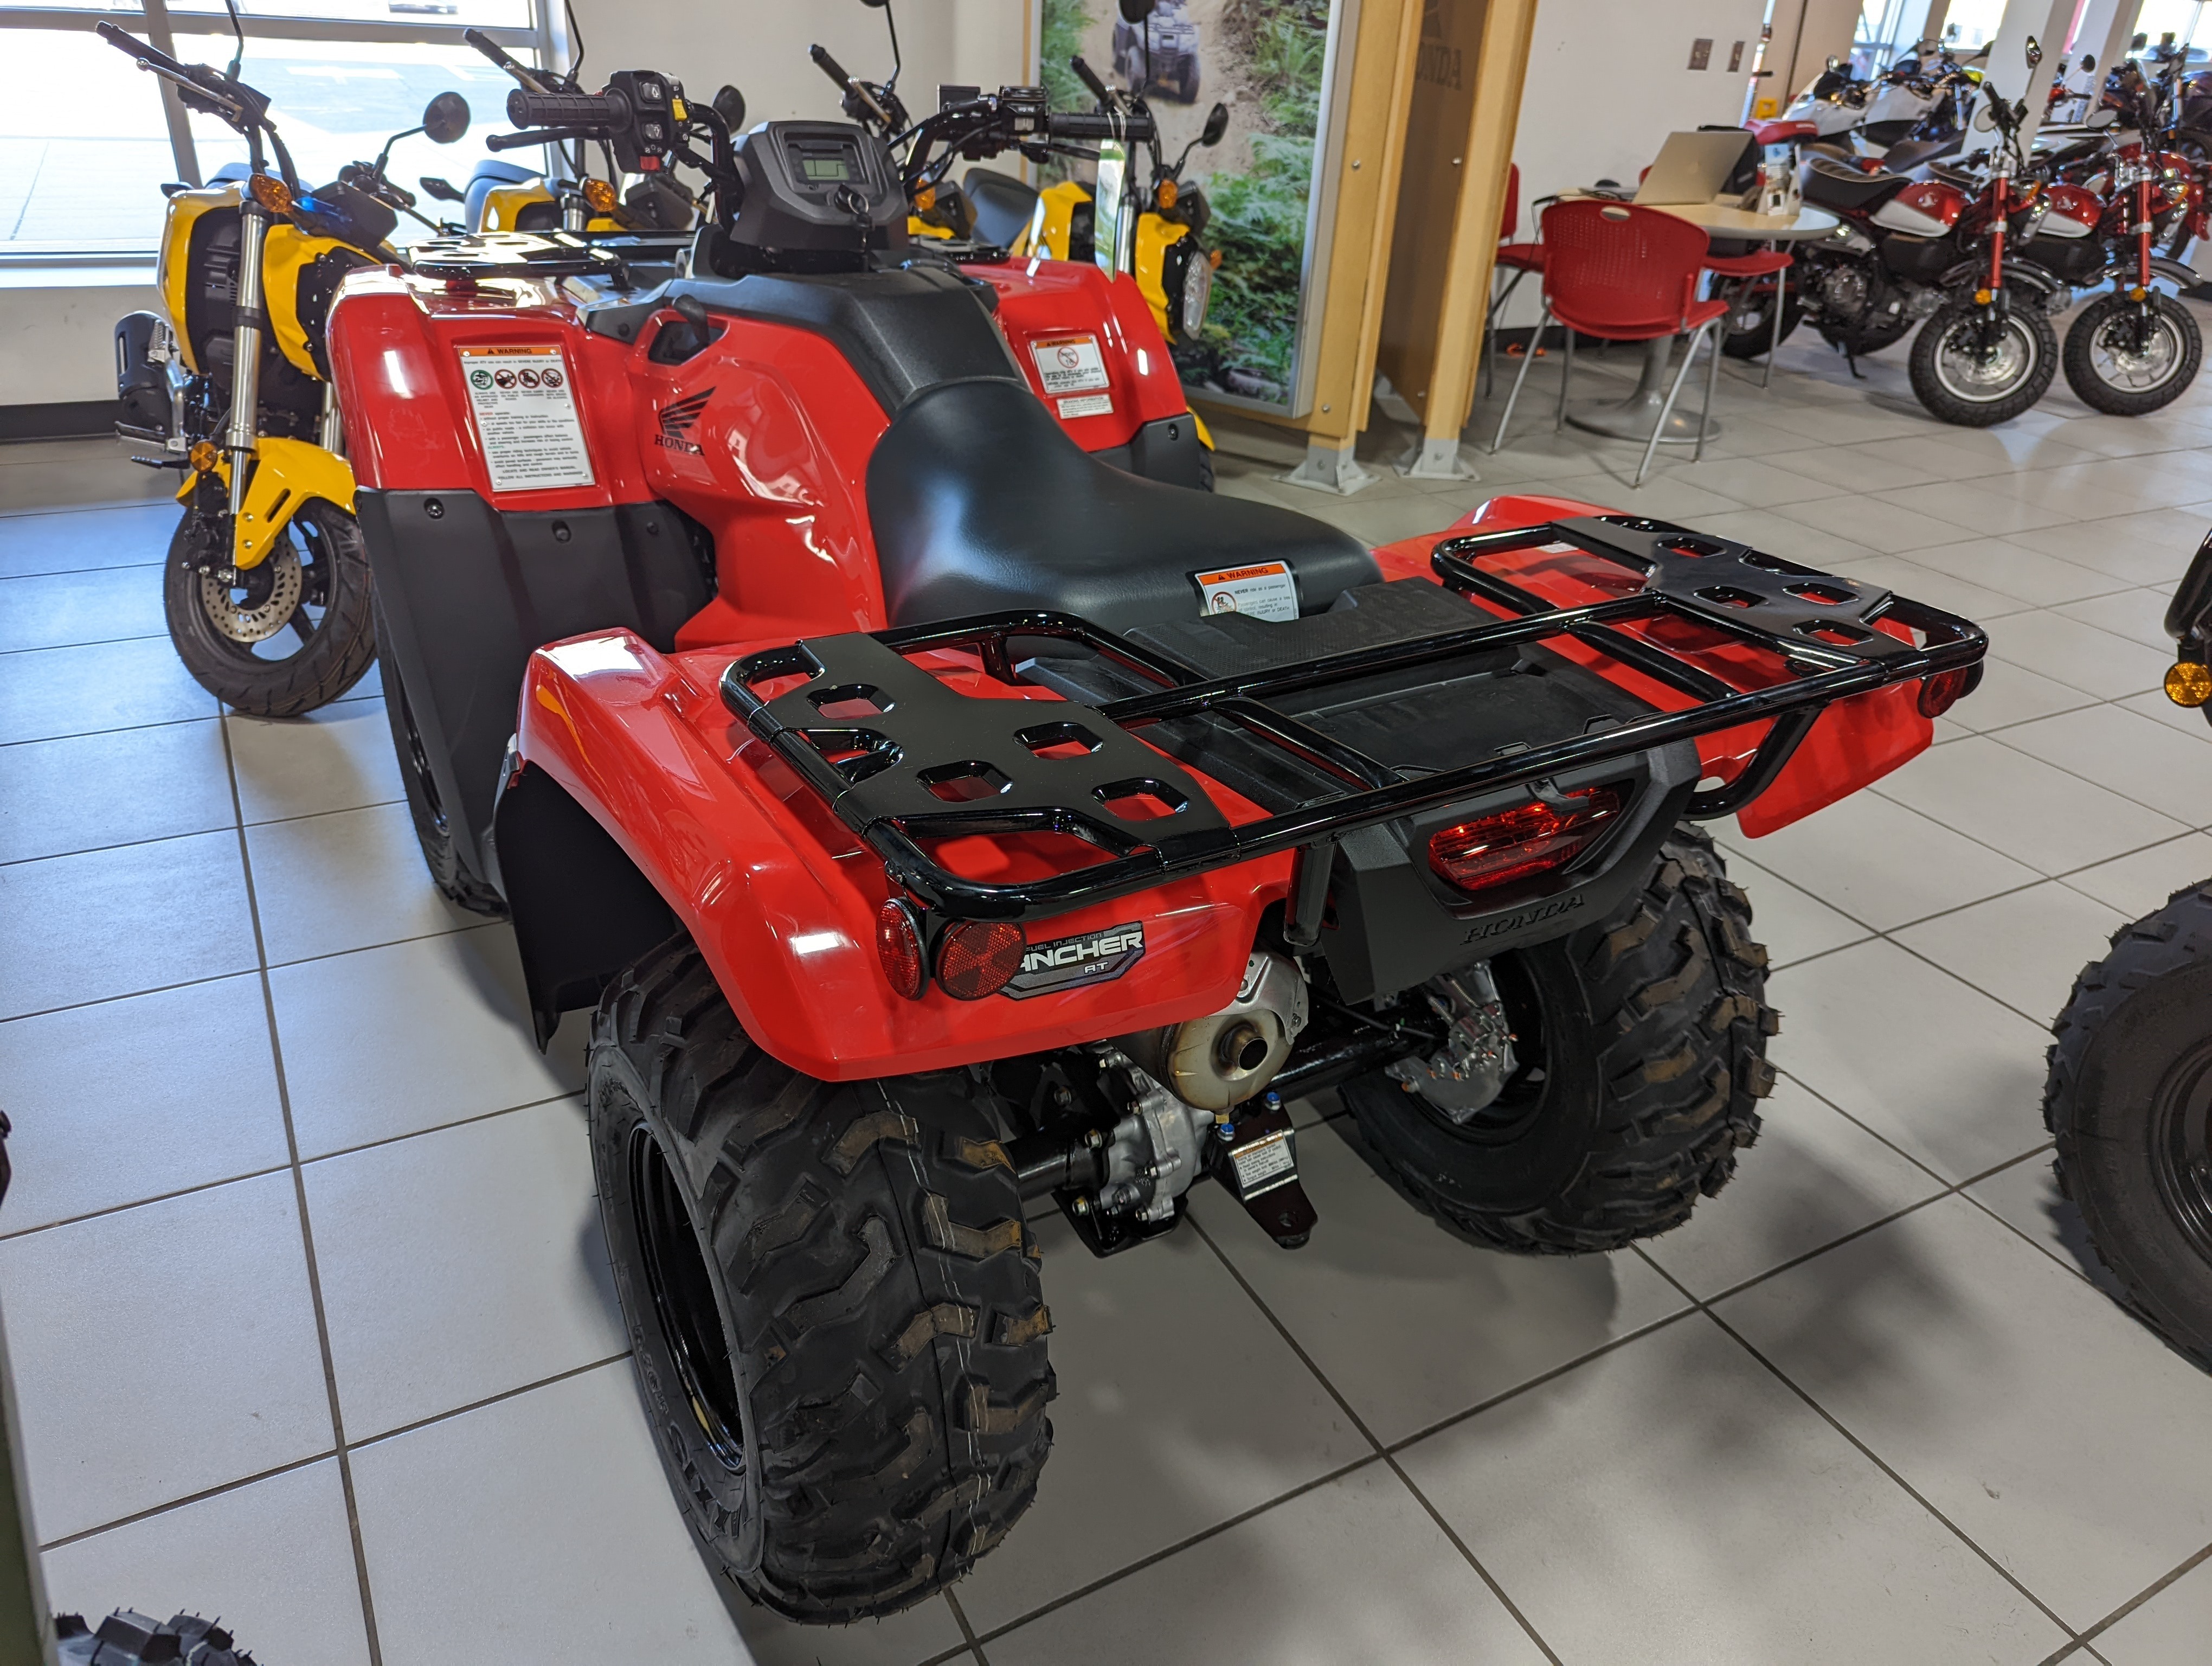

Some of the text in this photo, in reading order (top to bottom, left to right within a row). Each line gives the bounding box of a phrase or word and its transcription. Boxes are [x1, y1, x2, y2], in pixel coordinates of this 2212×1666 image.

[654, 434, 705, 456] HONDA
[1227, 568, 1268, 579] WARNING
[1459, 893, 1586, 946] HONDA
[1020, 931, 1143, 972] ANCHER
[1084, 962, 1108, 973] AT
